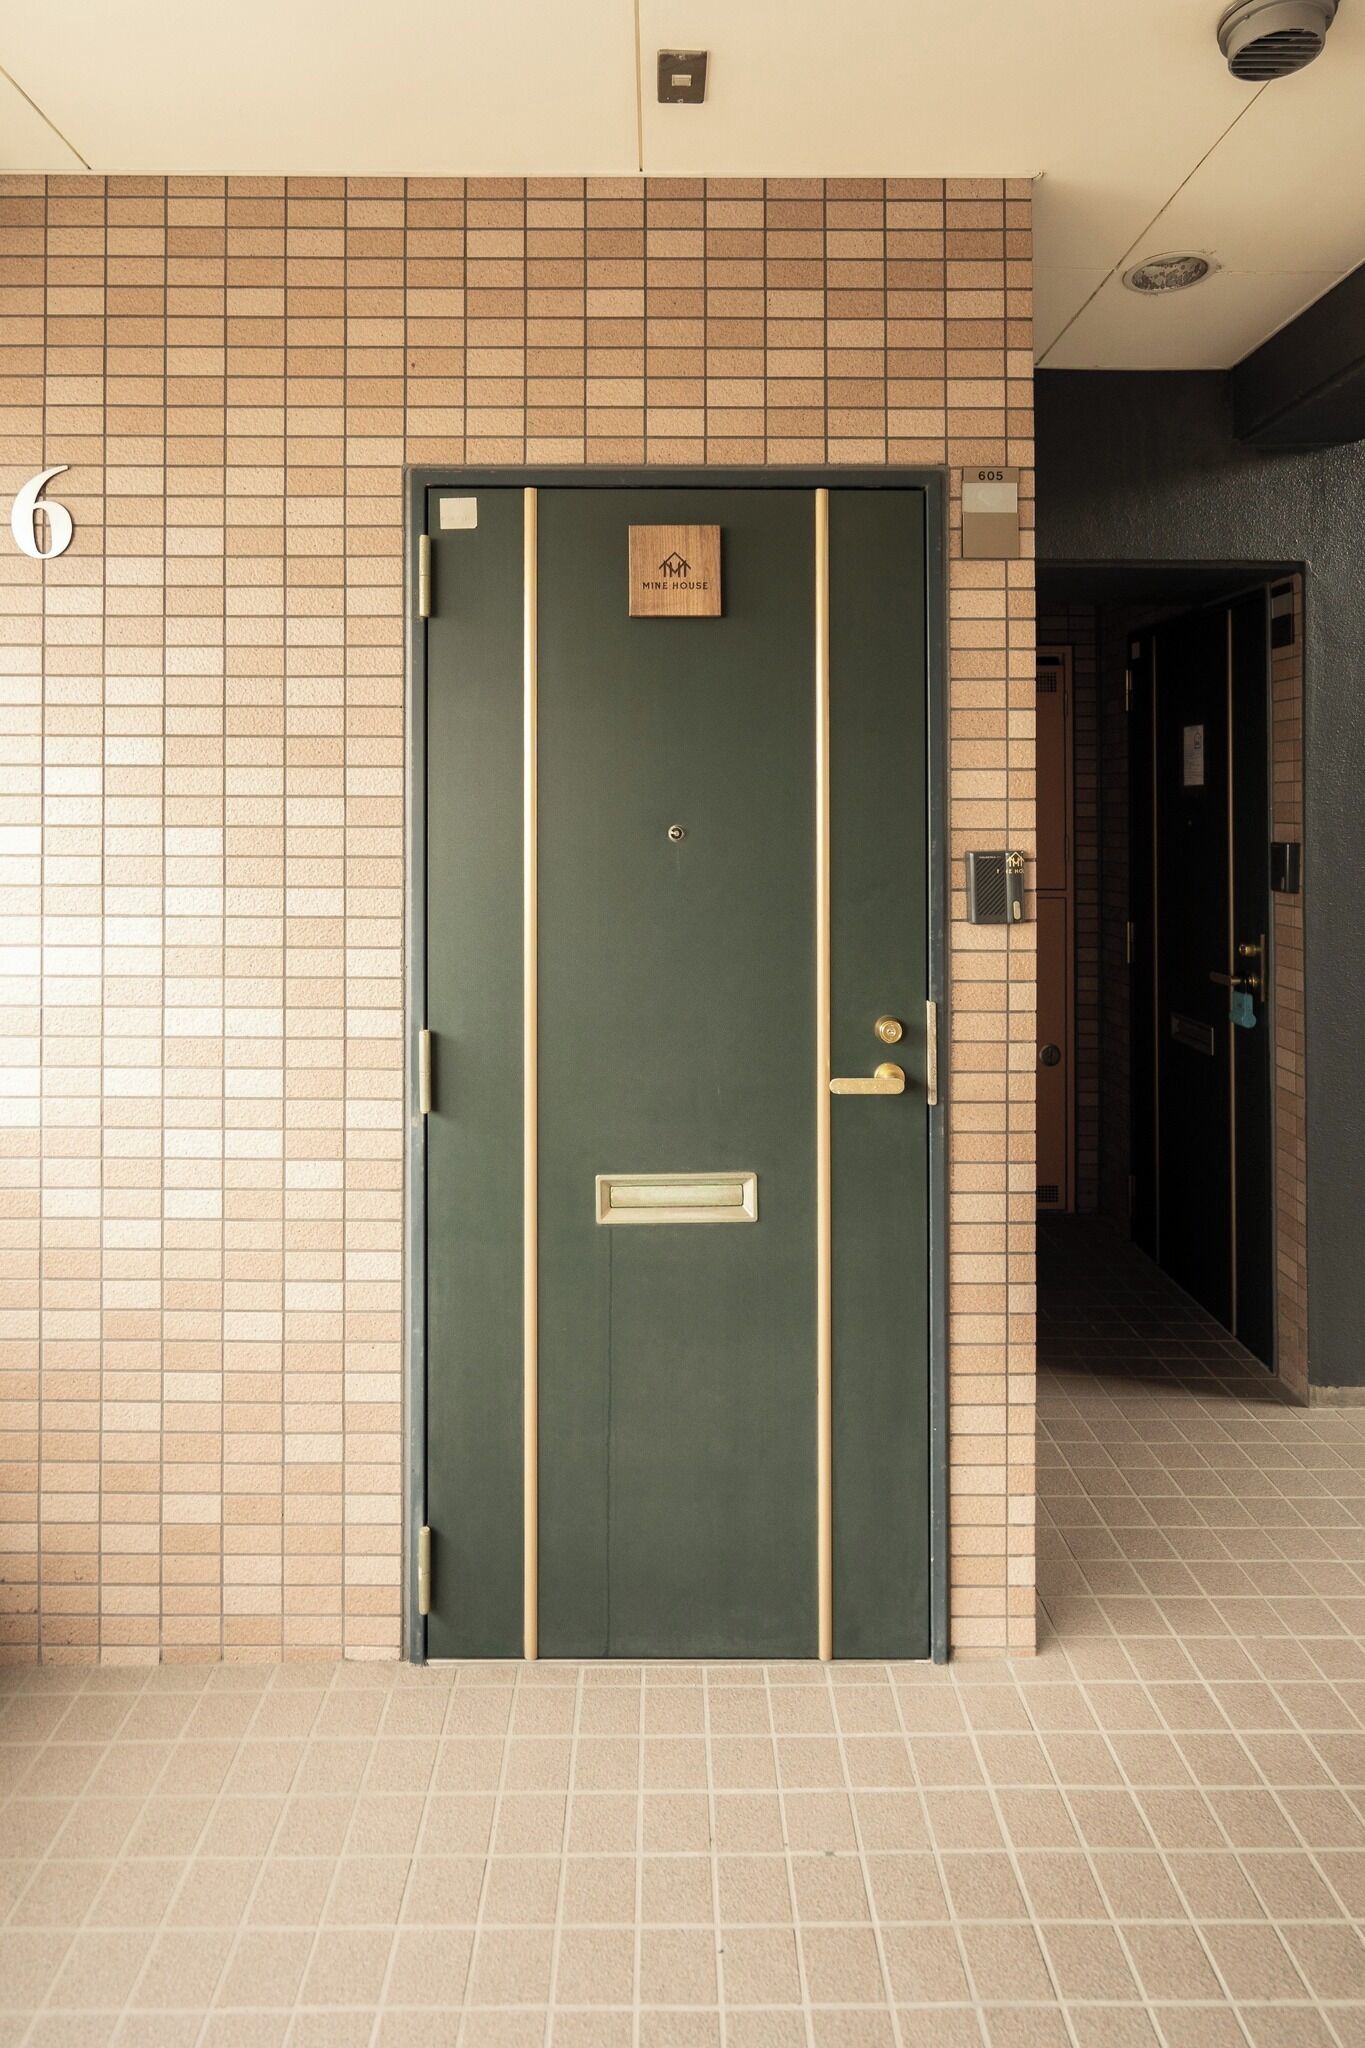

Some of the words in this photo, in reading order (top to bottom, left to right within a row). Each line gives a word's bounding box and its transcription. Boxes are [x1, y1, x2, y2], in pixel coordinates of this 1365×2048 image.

[978, 470, 1004, 481] 605
[11, 464, 73, 559] 6
[642, 581, 669, 590] MINE
[672, 581, 709, 590] HOUSE
